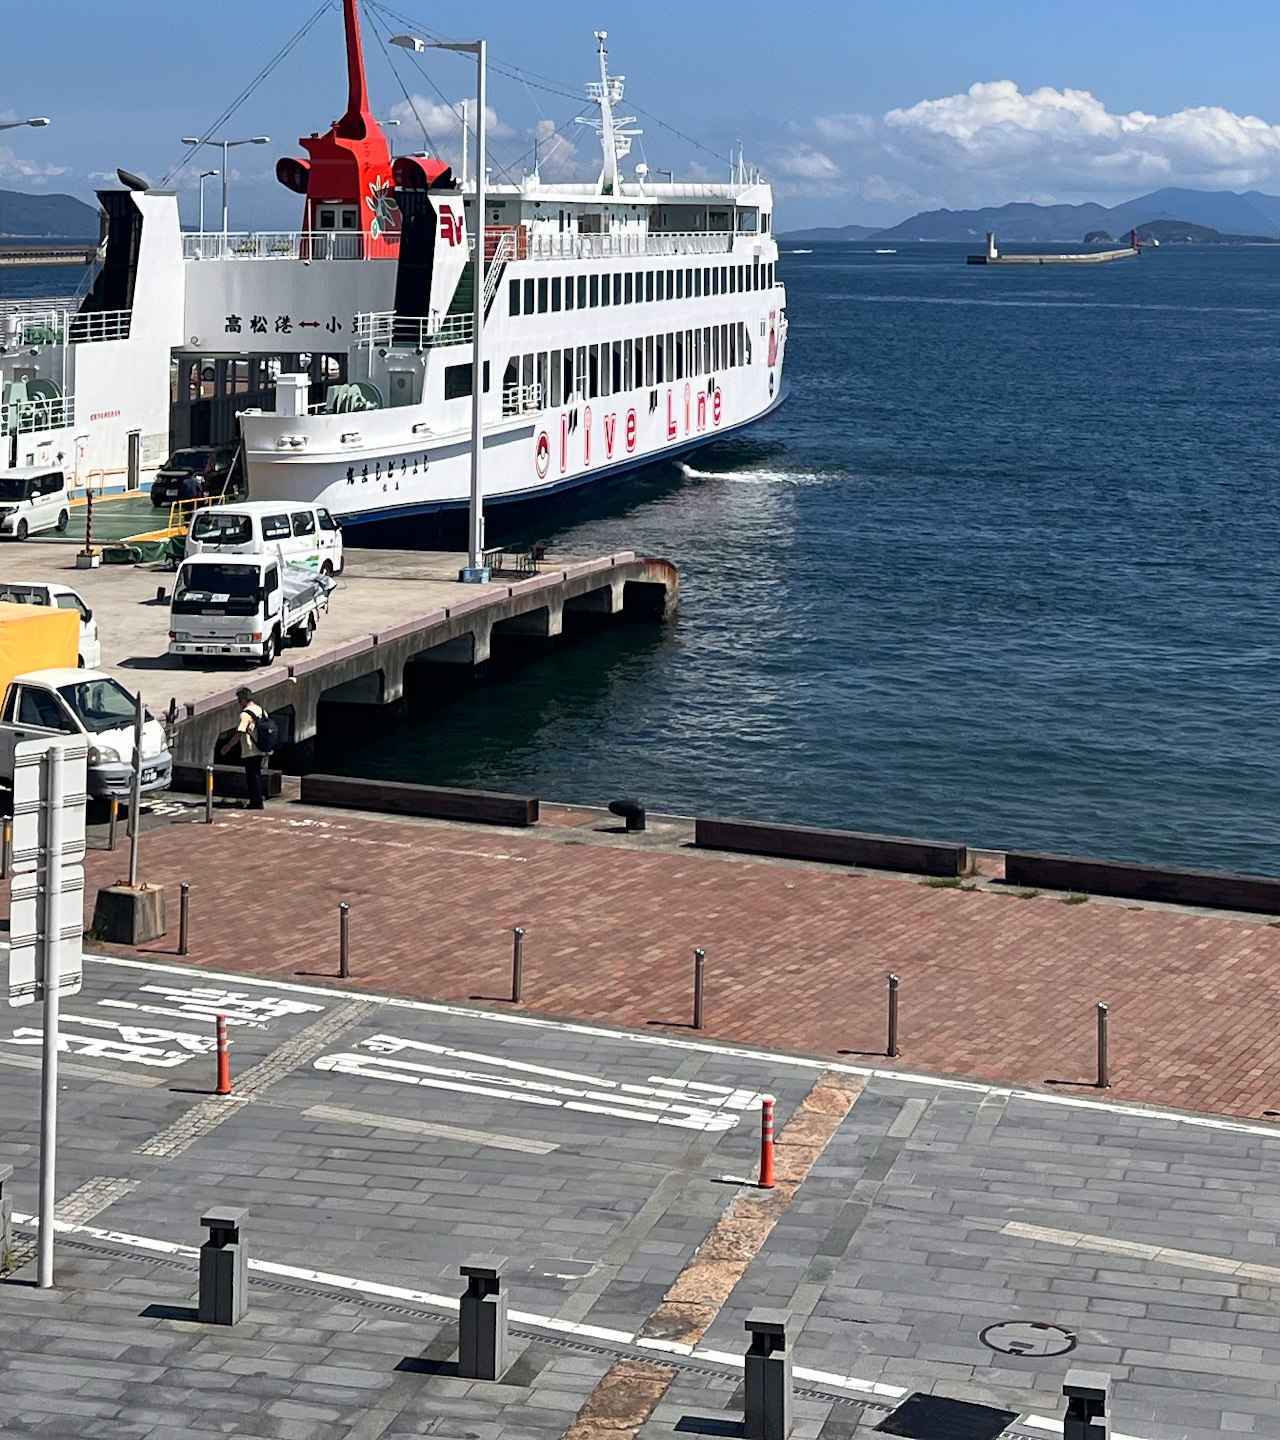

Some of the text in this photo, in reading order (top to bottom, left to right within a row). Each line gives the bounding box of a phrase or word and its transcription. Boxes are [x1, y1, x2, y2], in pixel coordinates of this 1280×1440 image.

[225, 314, 293, 334] 高松港
[535, 382, 722, 479] Olive Line
